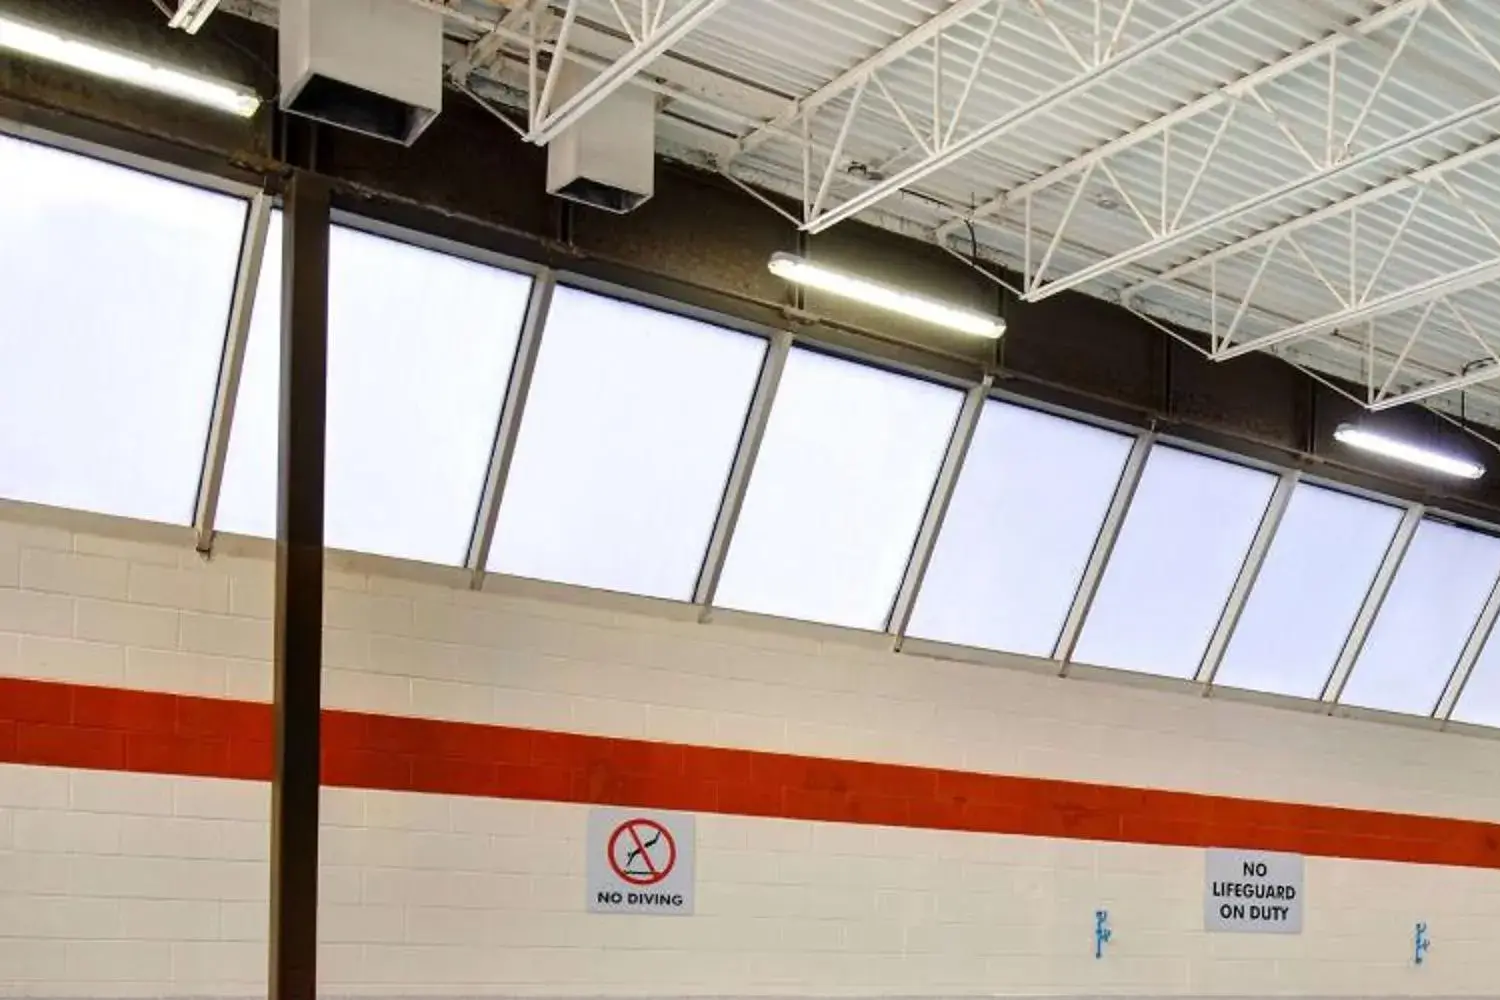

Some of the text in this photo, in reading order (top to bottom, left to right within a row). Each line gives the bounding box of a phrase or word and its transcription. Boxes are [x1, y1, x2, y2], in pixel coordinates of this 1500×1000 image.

[1243, 862, 1267, 877] NO
[597, 892, 683, 906] NO DIVING
[1212, 882, 1296, 900] LIFEGUARD
[1220, 904, 1289, 921] ON DUTY
